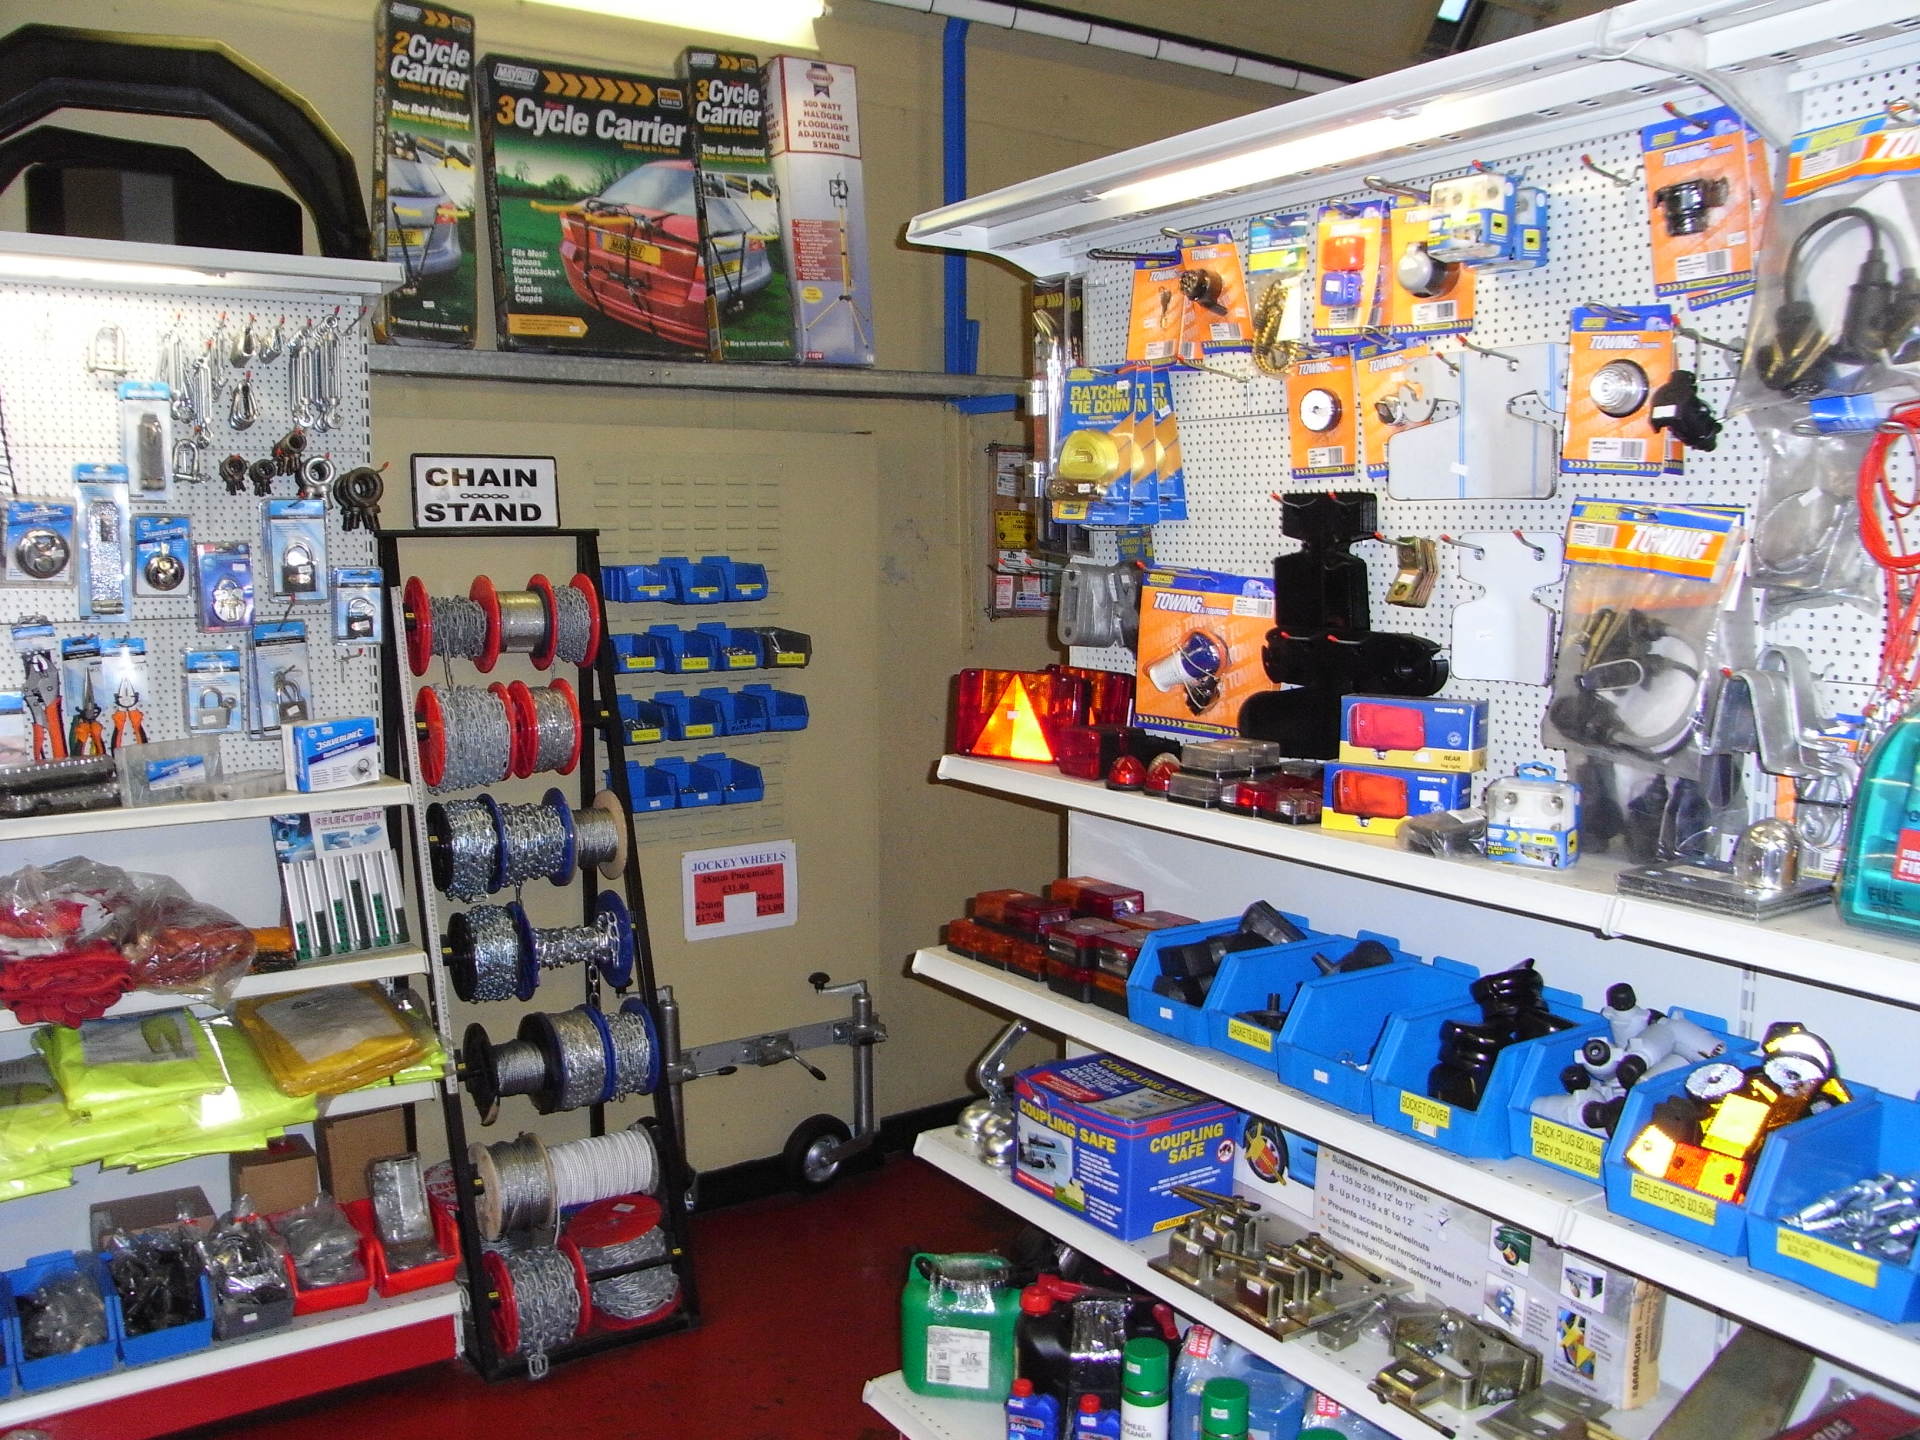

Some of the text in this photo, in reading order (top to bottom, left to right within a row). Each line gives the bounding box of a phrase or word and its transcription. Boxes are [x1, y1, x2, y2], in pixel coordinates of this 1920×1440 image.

[391, 54, 470, 91] Carrier
[696, 101, 762, 127] Carrier
[804, 111, 843, 121] HALOGEN
[820, 102, 841, 111] WATT
[596, 109, 687, 146] Carrier
[797, 119, 849, 132] FLOODLIGHT
[798, 130, 850, 142] ADJUSTABLE
[702, 144, 717, 153] Tow
[812, 141, 840, 150] STAND
[511, 248, 529, 257] Fits
[512, 258, 541, 267] Saloons
[515, 285, 542, 293] Estates
[1590, 334, 1639, 349] TOWING
[1071, 399, 1131, 414] TIE DOWN
[425, 467, 537, 487] CHAIN
[424, 503, 541, 522] STAND
[1627, 524, 1716, 560] TOWING
[1153, 592, 1204, 616] TOWING
[692, 852, 787, 873] JOCKEY WHEELS
[1060, 1069, 1096, 1090] DEVICE
[1099, 1059, 1164, 1091] COUPLING
[1402, 1095, 1448, 1122] SOCKET COVER
[1019, 1098, 1118, 1154] COUPLING SAFE
[1534, 1121, 1556, 1138] BLACK
[1556, 1129, 1575, 1147] PLUG
[1150, 1122, 1224, 1153] COUPLING
[1168, 1142, 1206, 1164] SAFE
[1536, 1141, 1554, 1156] GREY
[1555, 1147, 1574, 1165] PLUG
[1359, 1166, 1369, 1177] for
[1371, 1173, 1408, 1193] wheel/tyre
[1395, 1198, 1403, 1207] to
[1634, 1179, 1686, 1208] REFLECTORS
[1328, 1199, 1430, 1252] Prevents access to wheelnuts
[1391, 1212, 1400, 1222] to
[1328, 1213, 1341, 1224] Can
[1352, 1225, 1369, 1239] used
[1371, 1233, 1397, 1251] without
[1398, 1247, 1432, 1270] removing
[1433, 1263, 1456, 1280] wheel
[1457, 1274, 1473, 1287] trim
[1328, 1225, 1355, 1245] Ensures
[1362, 1242, 1384, 1261] highly
[1384, 1254, 1407, 1271] visible
[1408, 1266, 1443, 1289] deterrent
